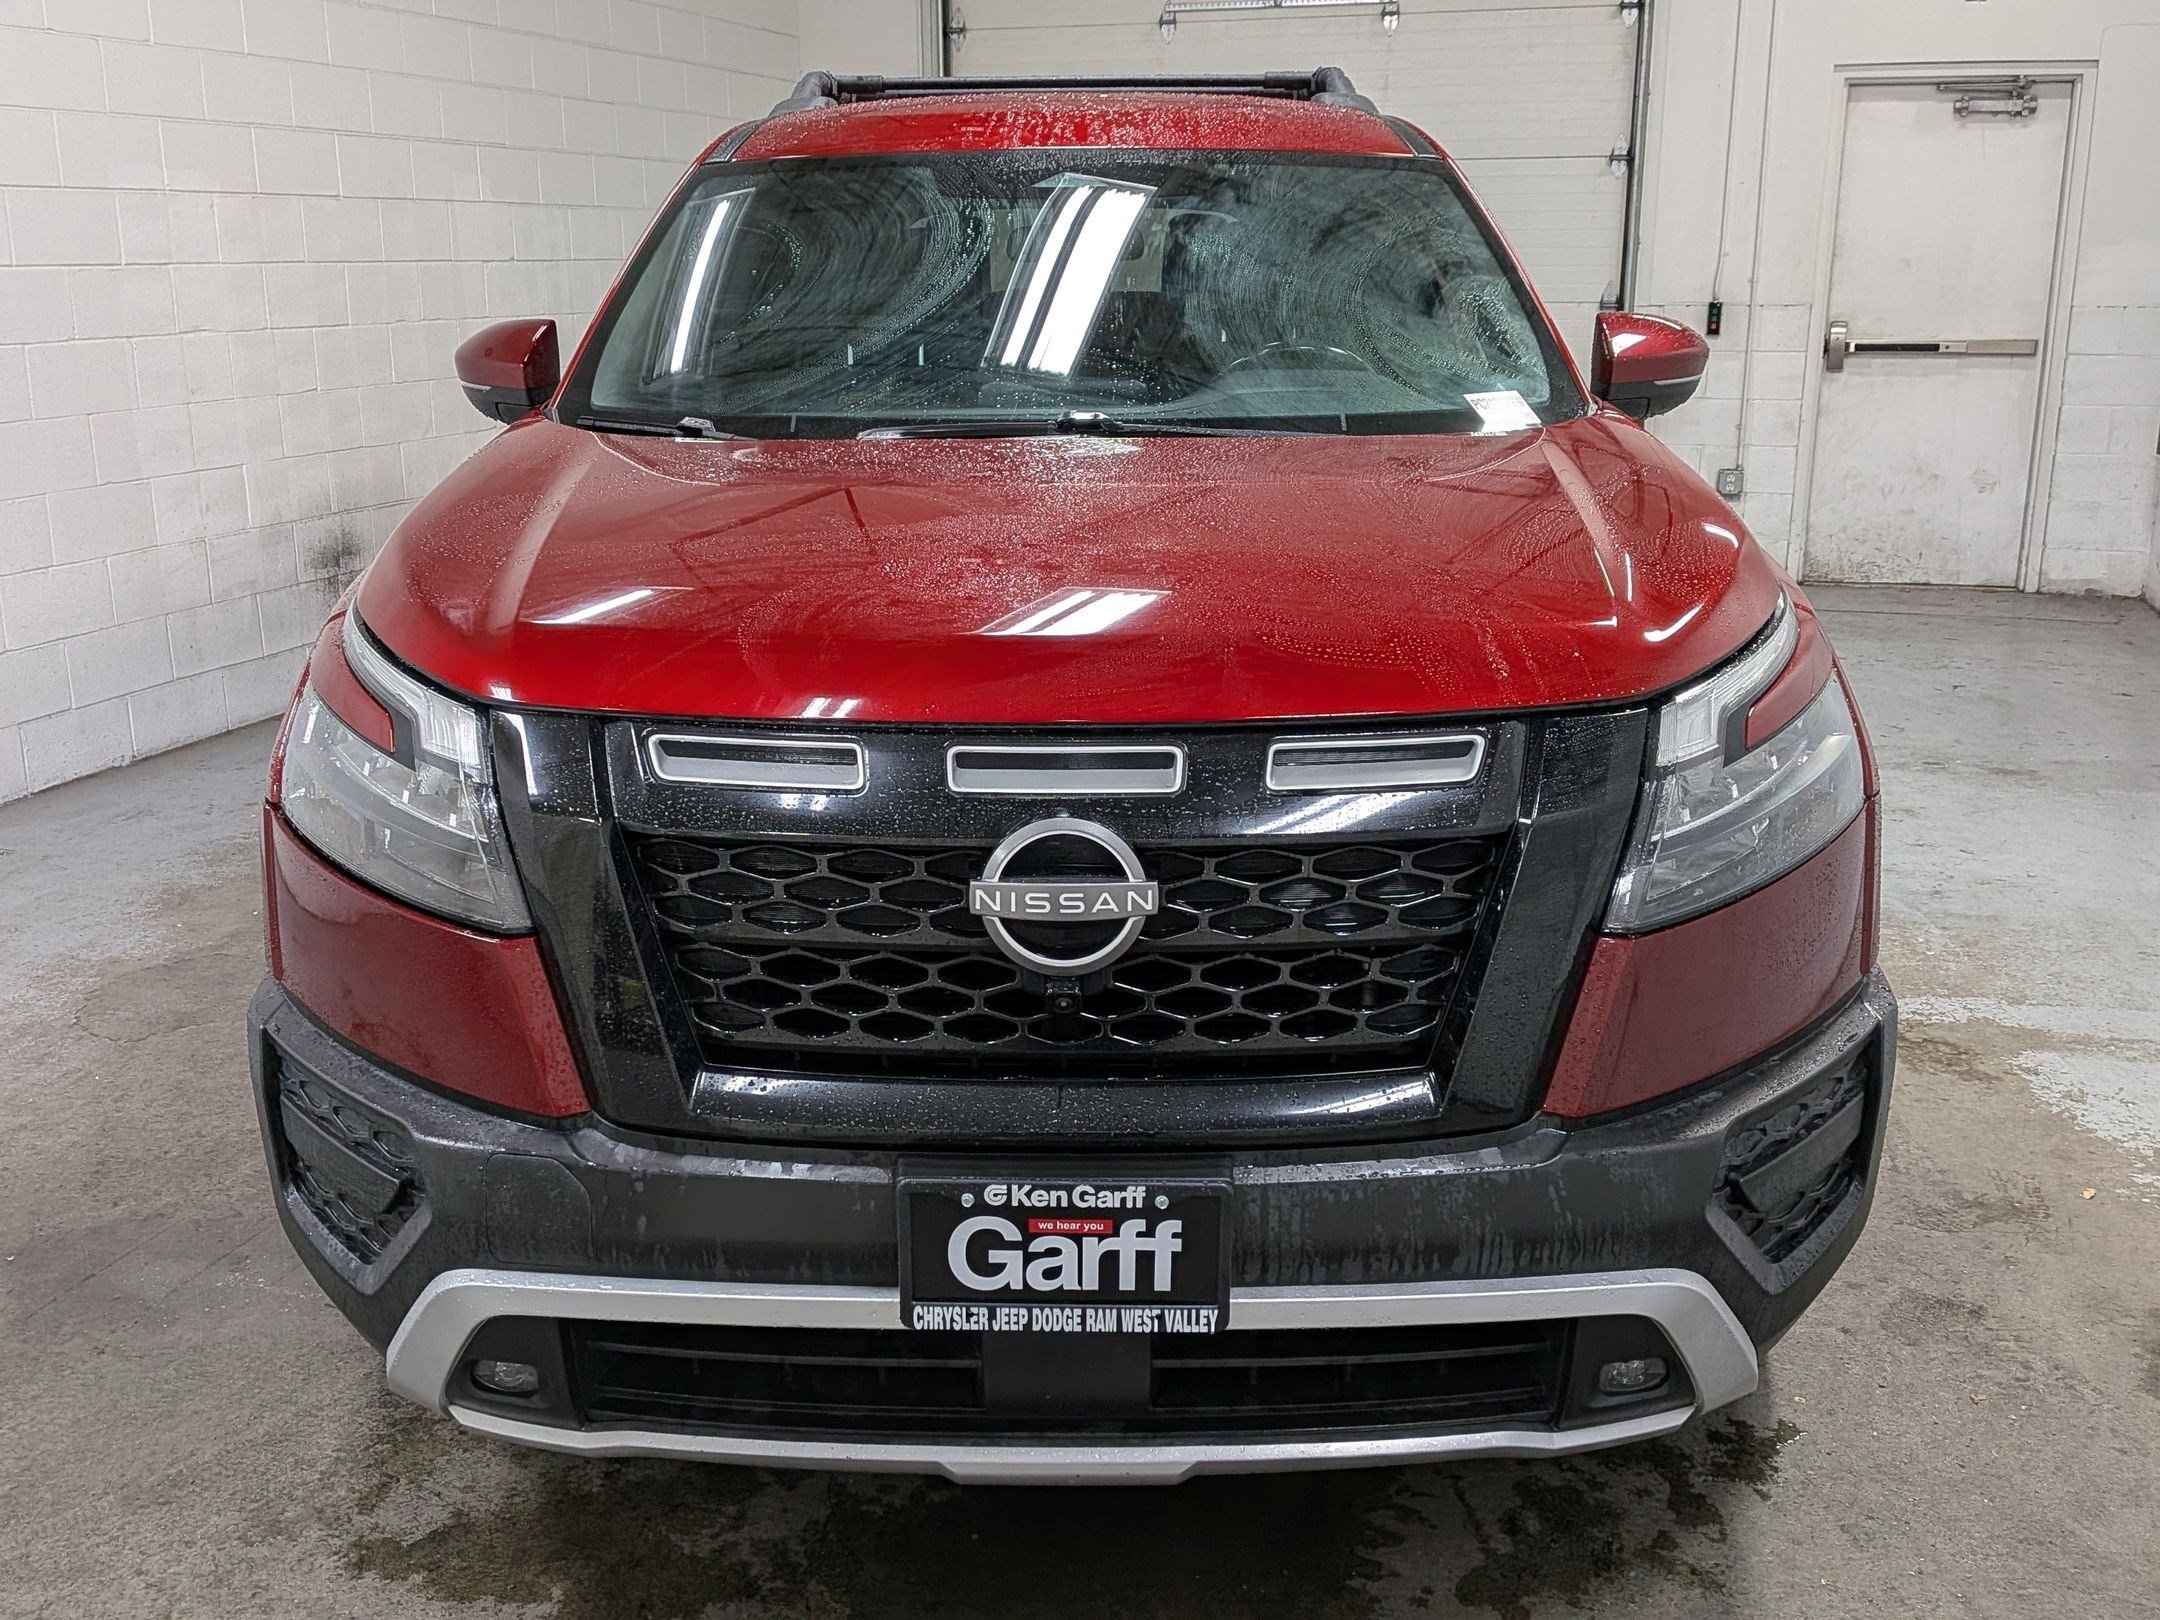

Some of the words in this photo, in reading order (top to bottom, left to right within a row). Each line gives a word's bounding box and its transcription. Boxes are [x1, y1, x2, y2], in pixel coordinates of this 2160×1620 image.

[975, 889, 1153, 914] NISSAN
[1011, 1184, 1069, 1208] Ken
[1072, 1185, 1146, 1209] Garff
[1038, 1221, 1054, 1231] we
[1057, 1220, 1081, 1231] hear
[1083, 1221, 1104, 1232] you
[948, 1215, 1183, 1292] Garff
[913, 1305, 989, 1332] CHRYSLER
[992, 1307, 1028, 1332] JEEP
[1032, 1308, 1082, 1333] DODGE
[1086, 1308, 1118, 1334] RAM
[1121, 1309, 1161, 1334] WEST
[1164, 1308, 1219, 1335] VALLEY
